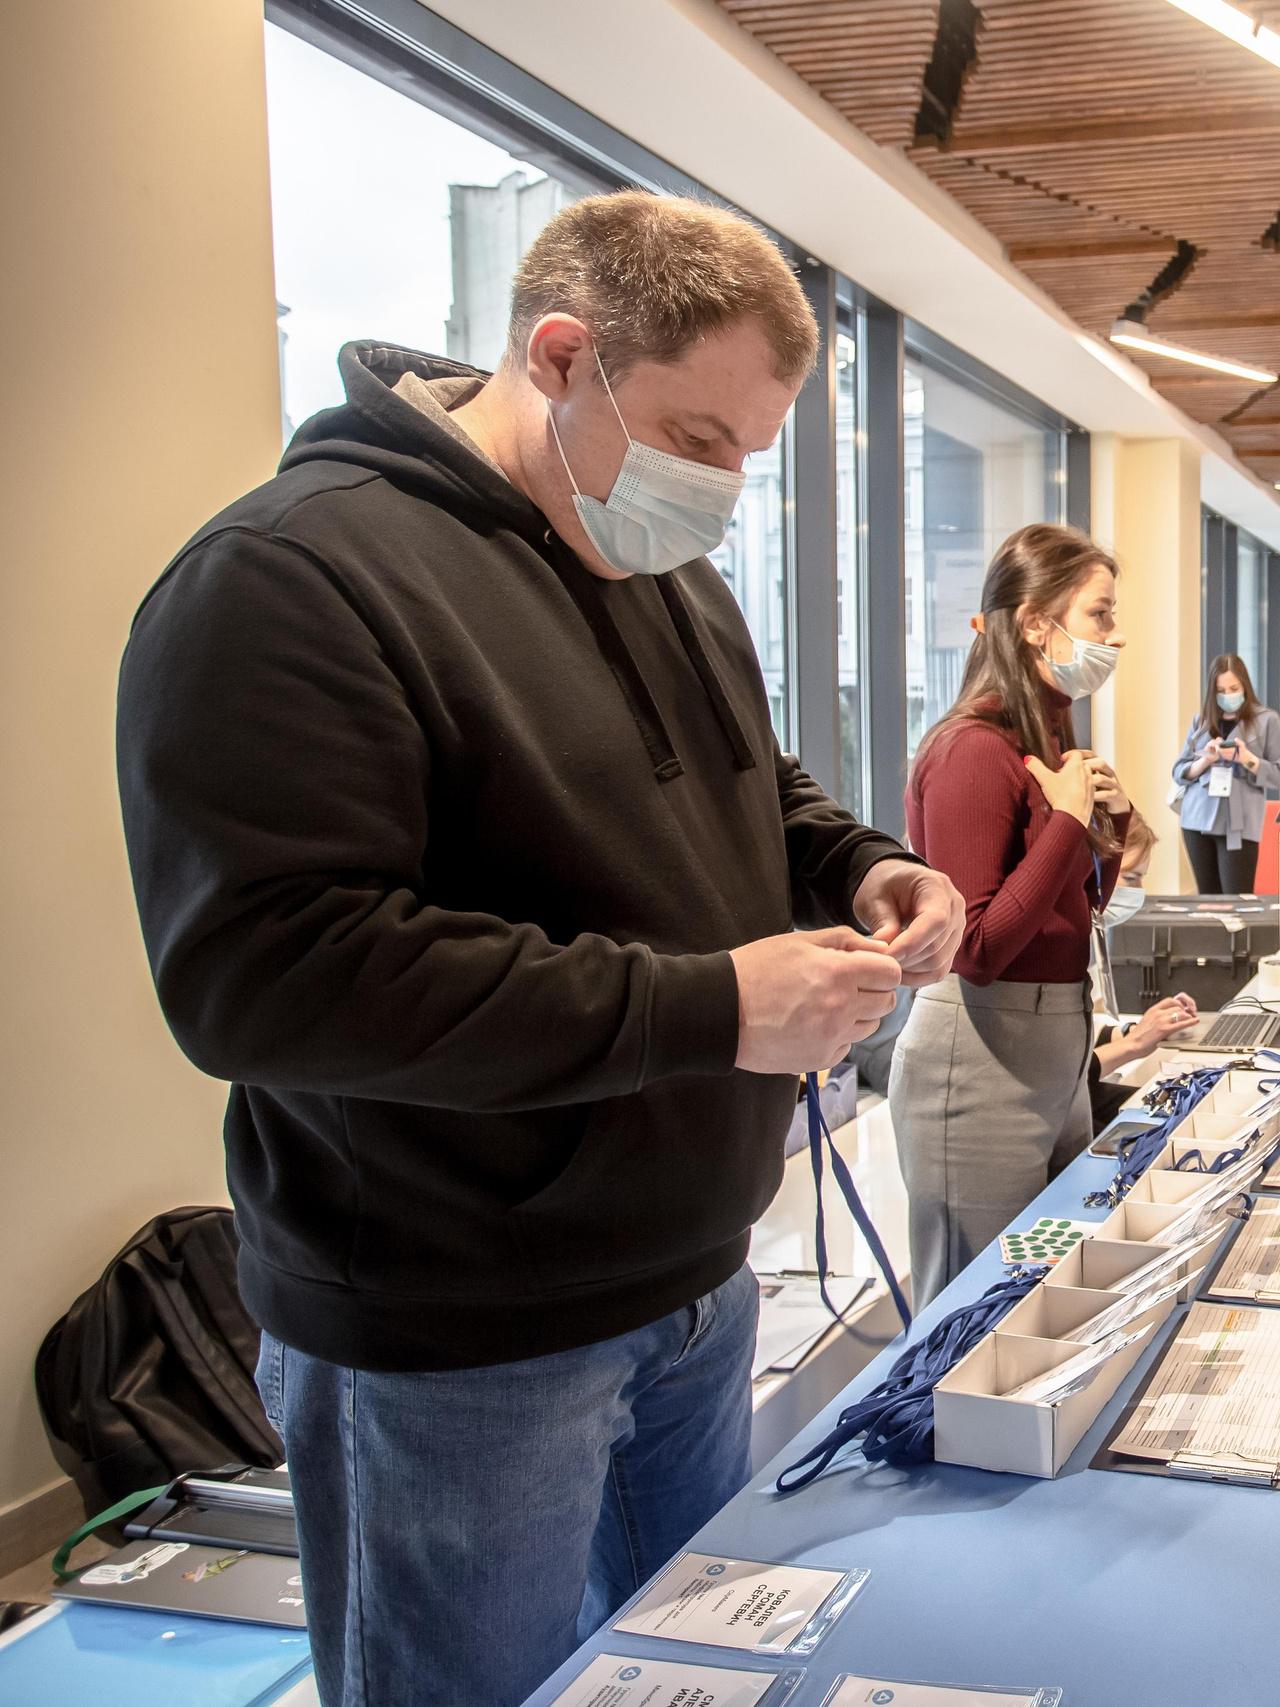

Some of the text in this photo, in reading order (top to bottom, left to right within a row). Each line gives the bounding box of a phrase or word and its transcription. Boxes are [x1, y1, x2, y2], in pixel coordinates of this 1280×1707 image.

[725, 1584, 768, 1625] СЕРГЕВИЧ
[743, 1592, 775, 1620] РОМАН
[752, 1589, 791, 1627] КОВАЛЕВ
